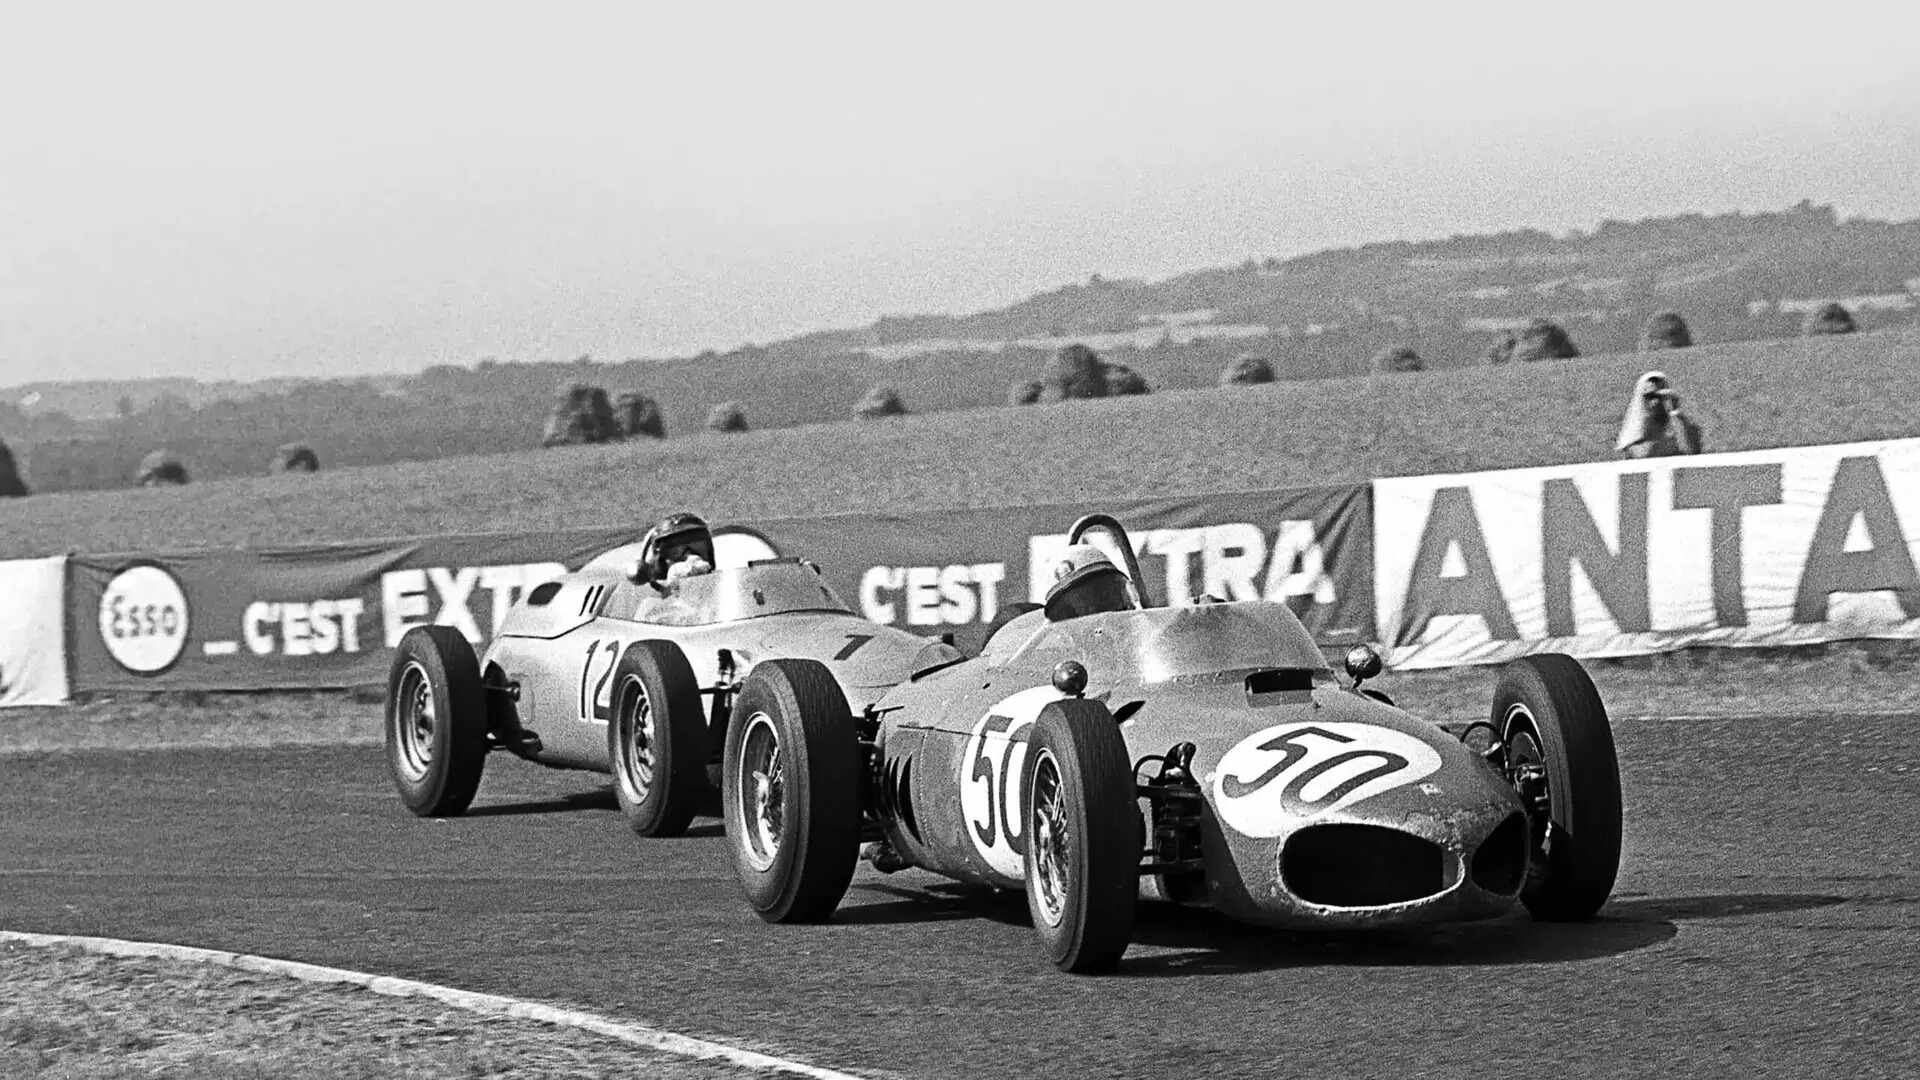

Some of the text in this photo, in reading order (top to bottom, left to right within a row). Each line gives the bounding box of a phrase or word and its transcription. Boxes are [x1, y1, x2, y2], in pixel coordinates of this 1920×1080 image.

[860, 562, 1005, 625] C'EST
[1396, 455, 1920, 647] ANTA
[243, 598, 364, 656] C'EST
[581, 639, 620, 720] 12
[972, 714, 1035, 856] 50
[1222, 726, 1409, 816] 50
